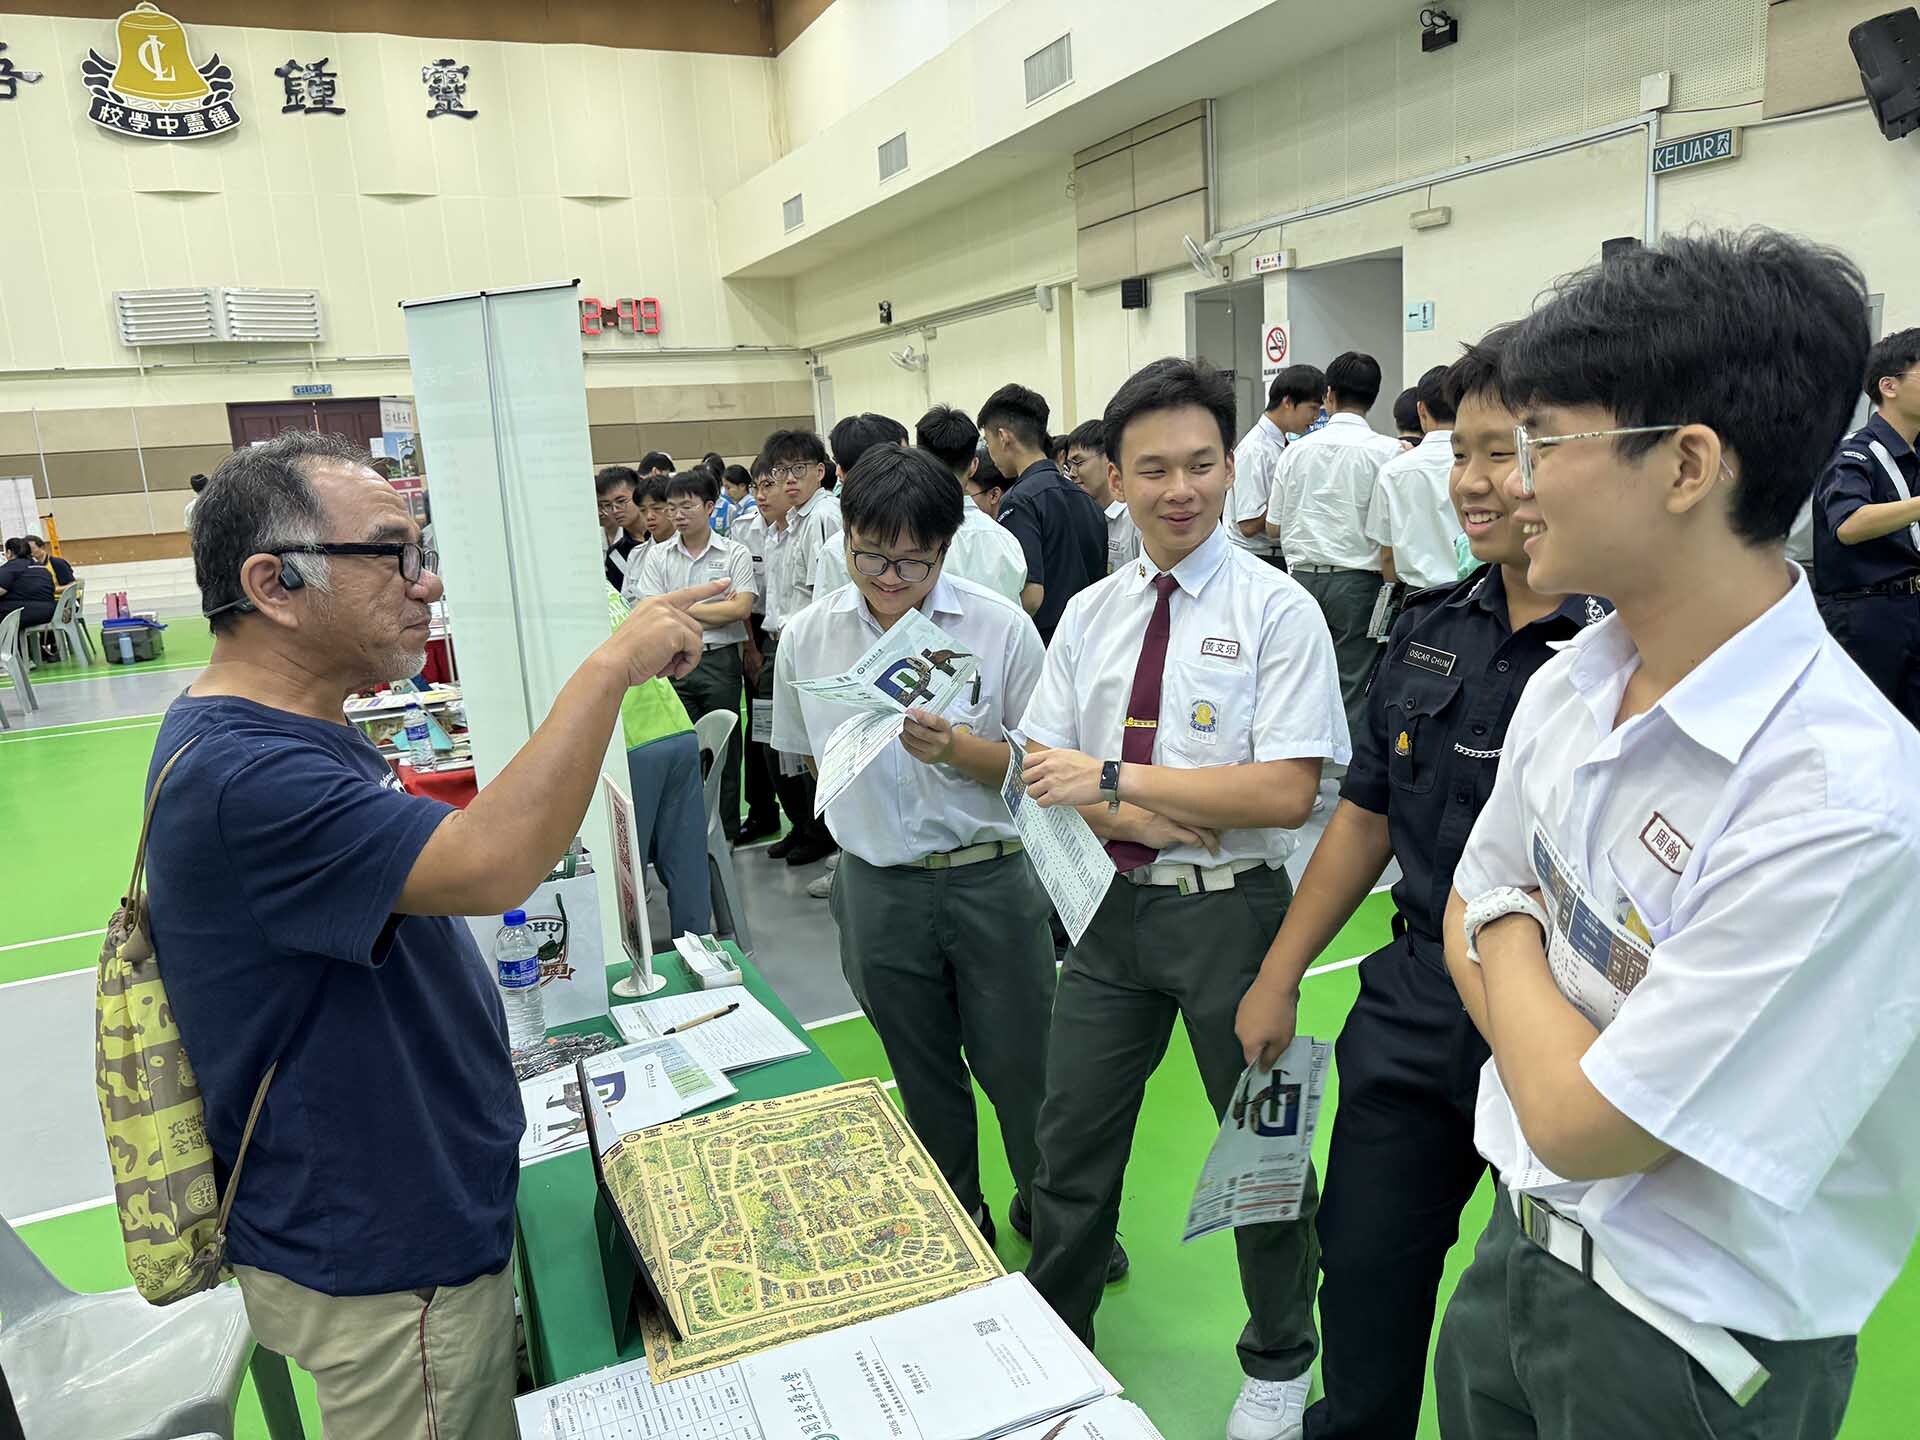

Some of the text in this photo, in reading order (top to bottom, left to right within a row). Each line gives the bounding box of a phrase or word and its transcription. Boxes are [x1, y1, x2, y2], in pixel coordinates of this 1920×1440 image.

[1655, 138, 1714, 170] KELUAR
[1409, 649, 1451, 668] OSCAR CHUM
